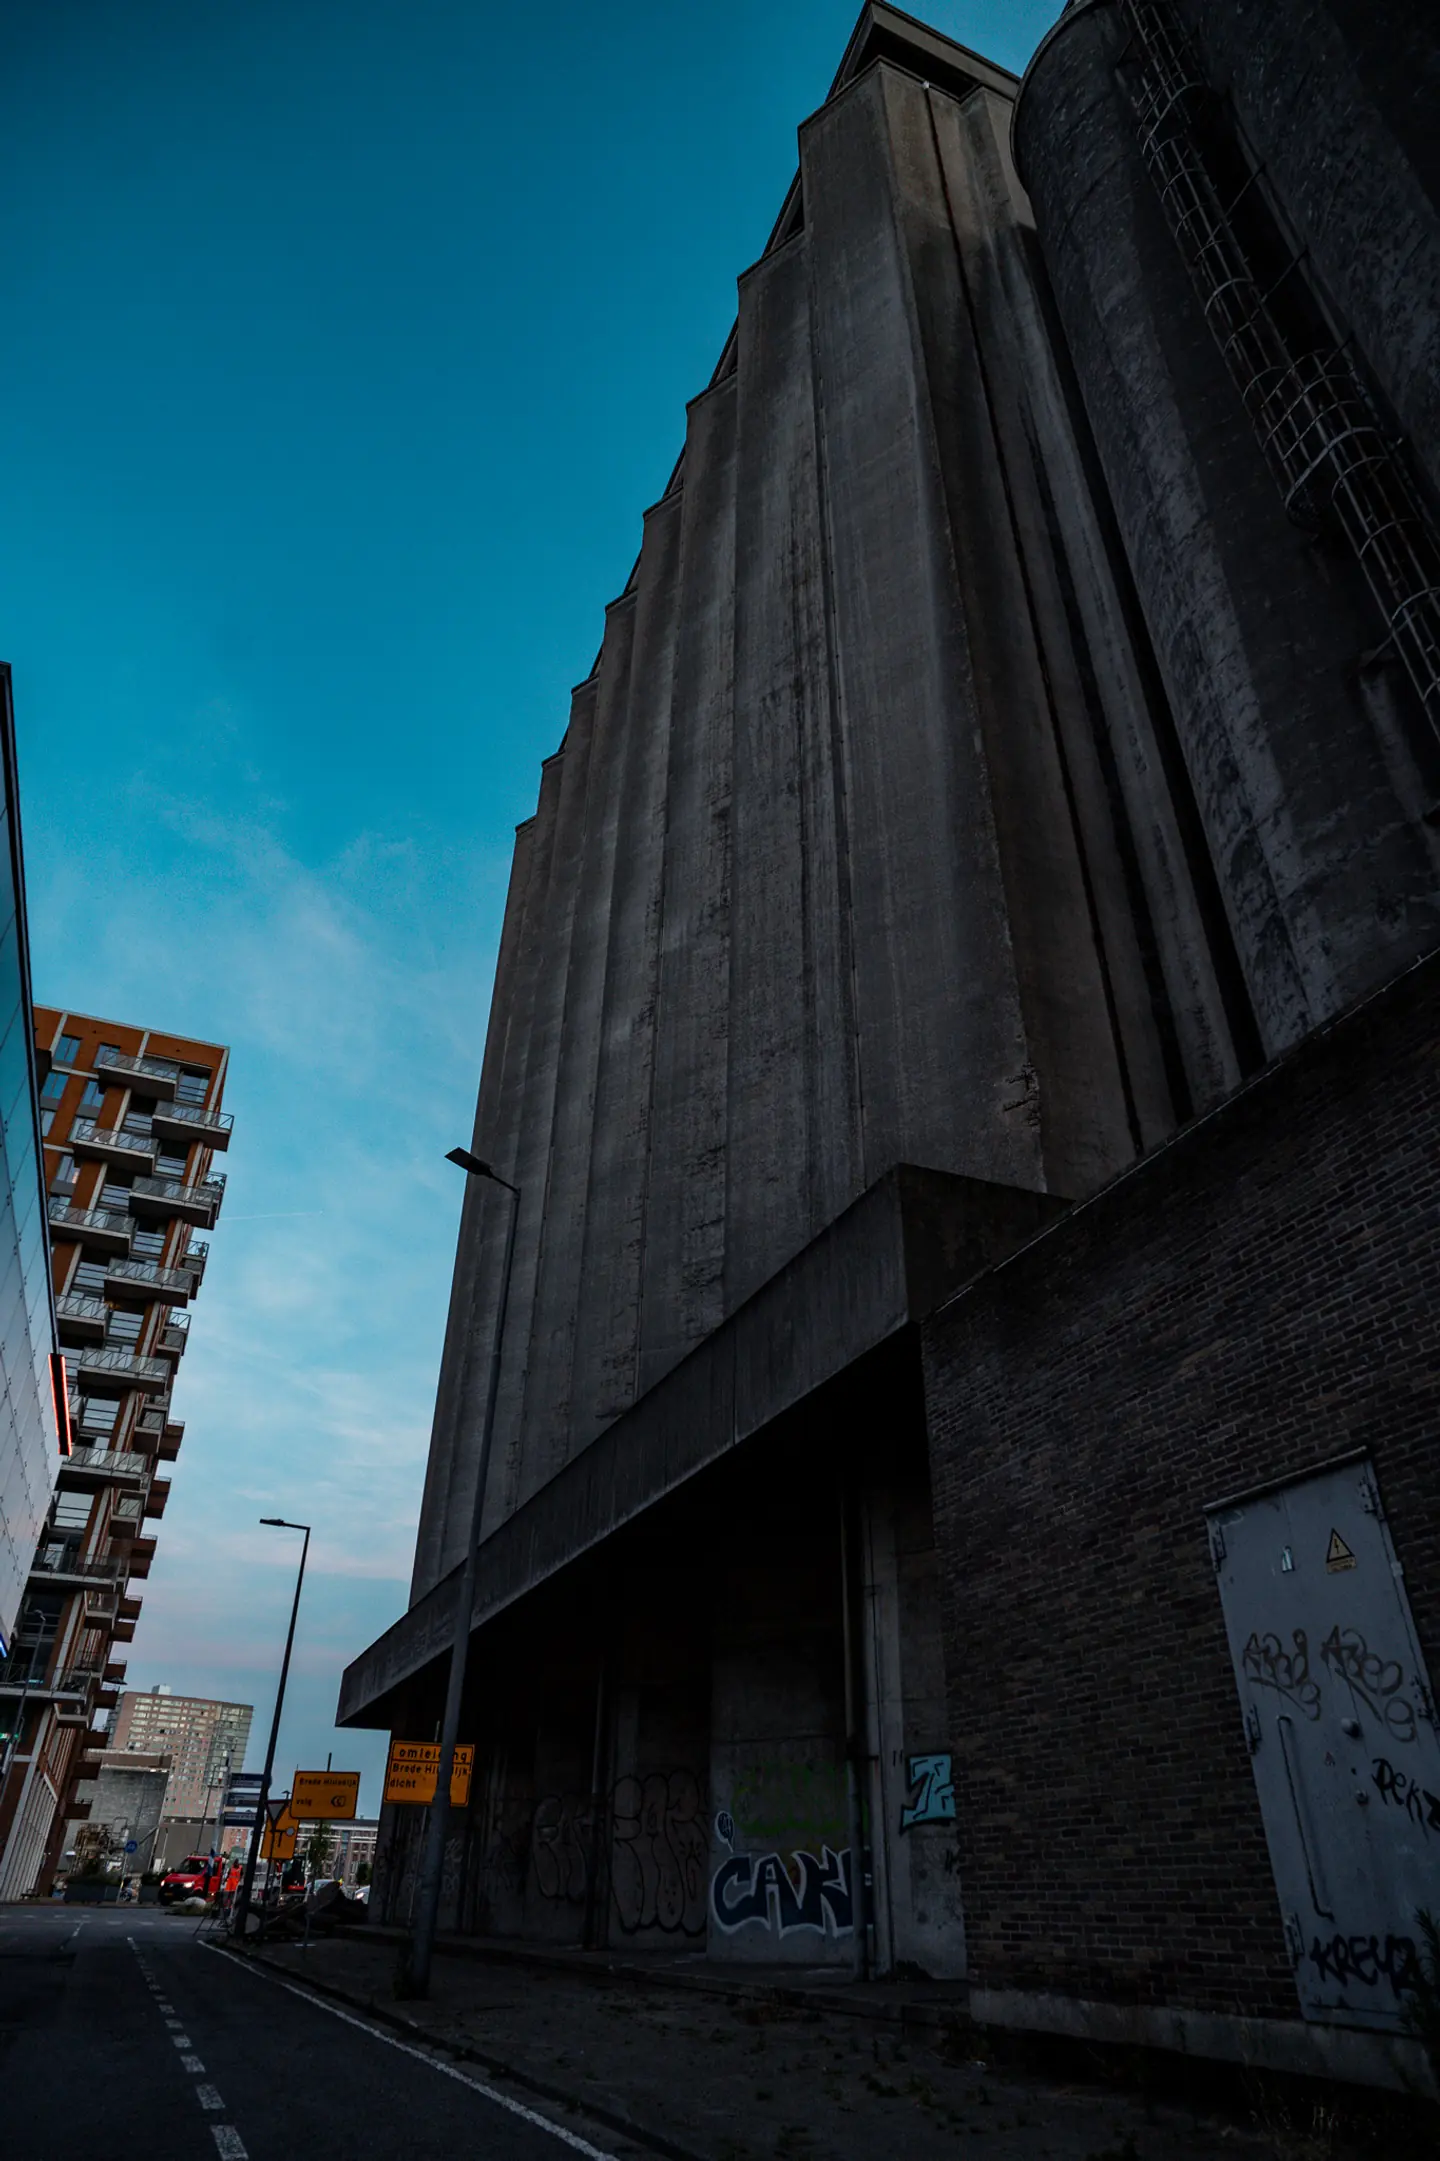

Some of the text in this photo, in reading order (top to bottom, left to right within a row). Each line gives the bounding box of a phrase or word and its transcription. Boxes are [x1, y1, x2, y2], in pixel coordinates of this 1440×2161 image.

[399, 1748, 468, 1763] omleing
[392, 1762, 468, 1777] Brede Hiijk
[390, 1778, 417, 1789] dicht
